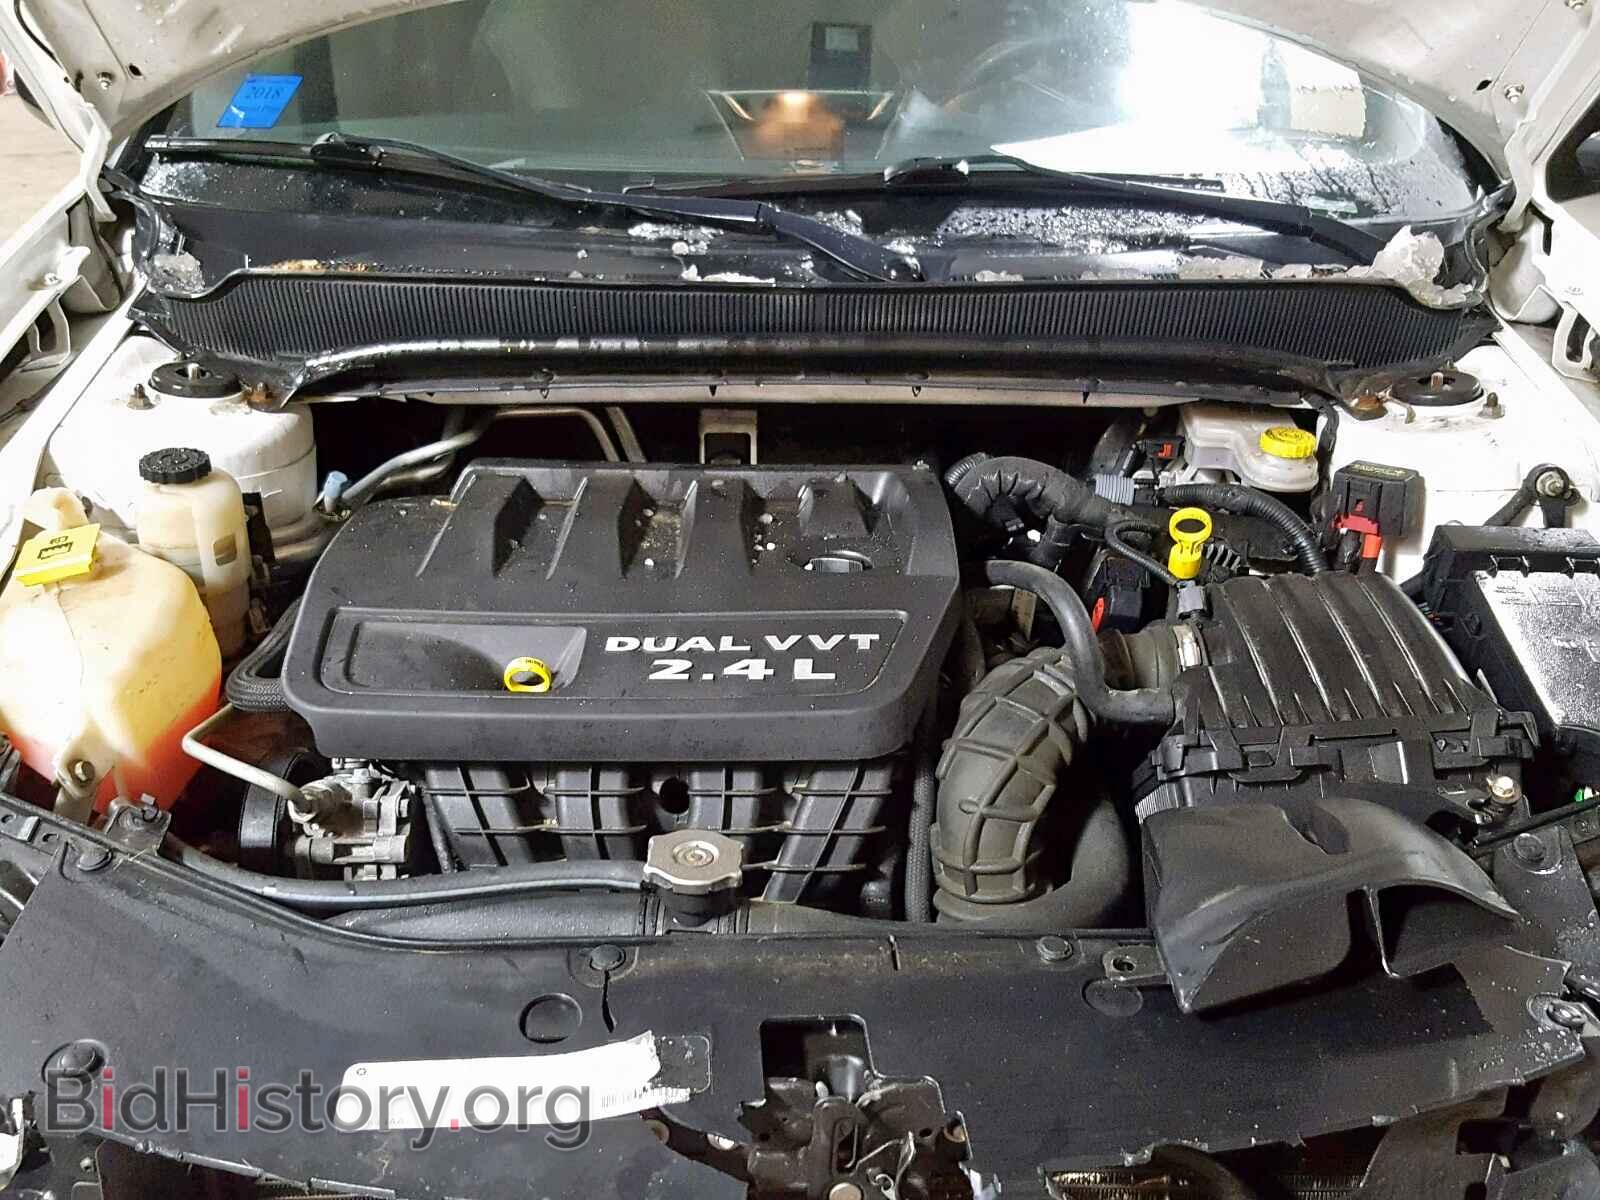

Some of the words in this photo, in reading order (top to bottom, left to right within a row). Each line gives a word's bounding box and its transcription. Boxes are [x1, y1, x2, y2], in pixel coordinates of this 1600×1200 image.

[605, 635, 752, 652] DUAL
[764, 634, 880, 650] VVT
[648, 658, 775, 681] 2.4
[793, 658, 837, 681] L
